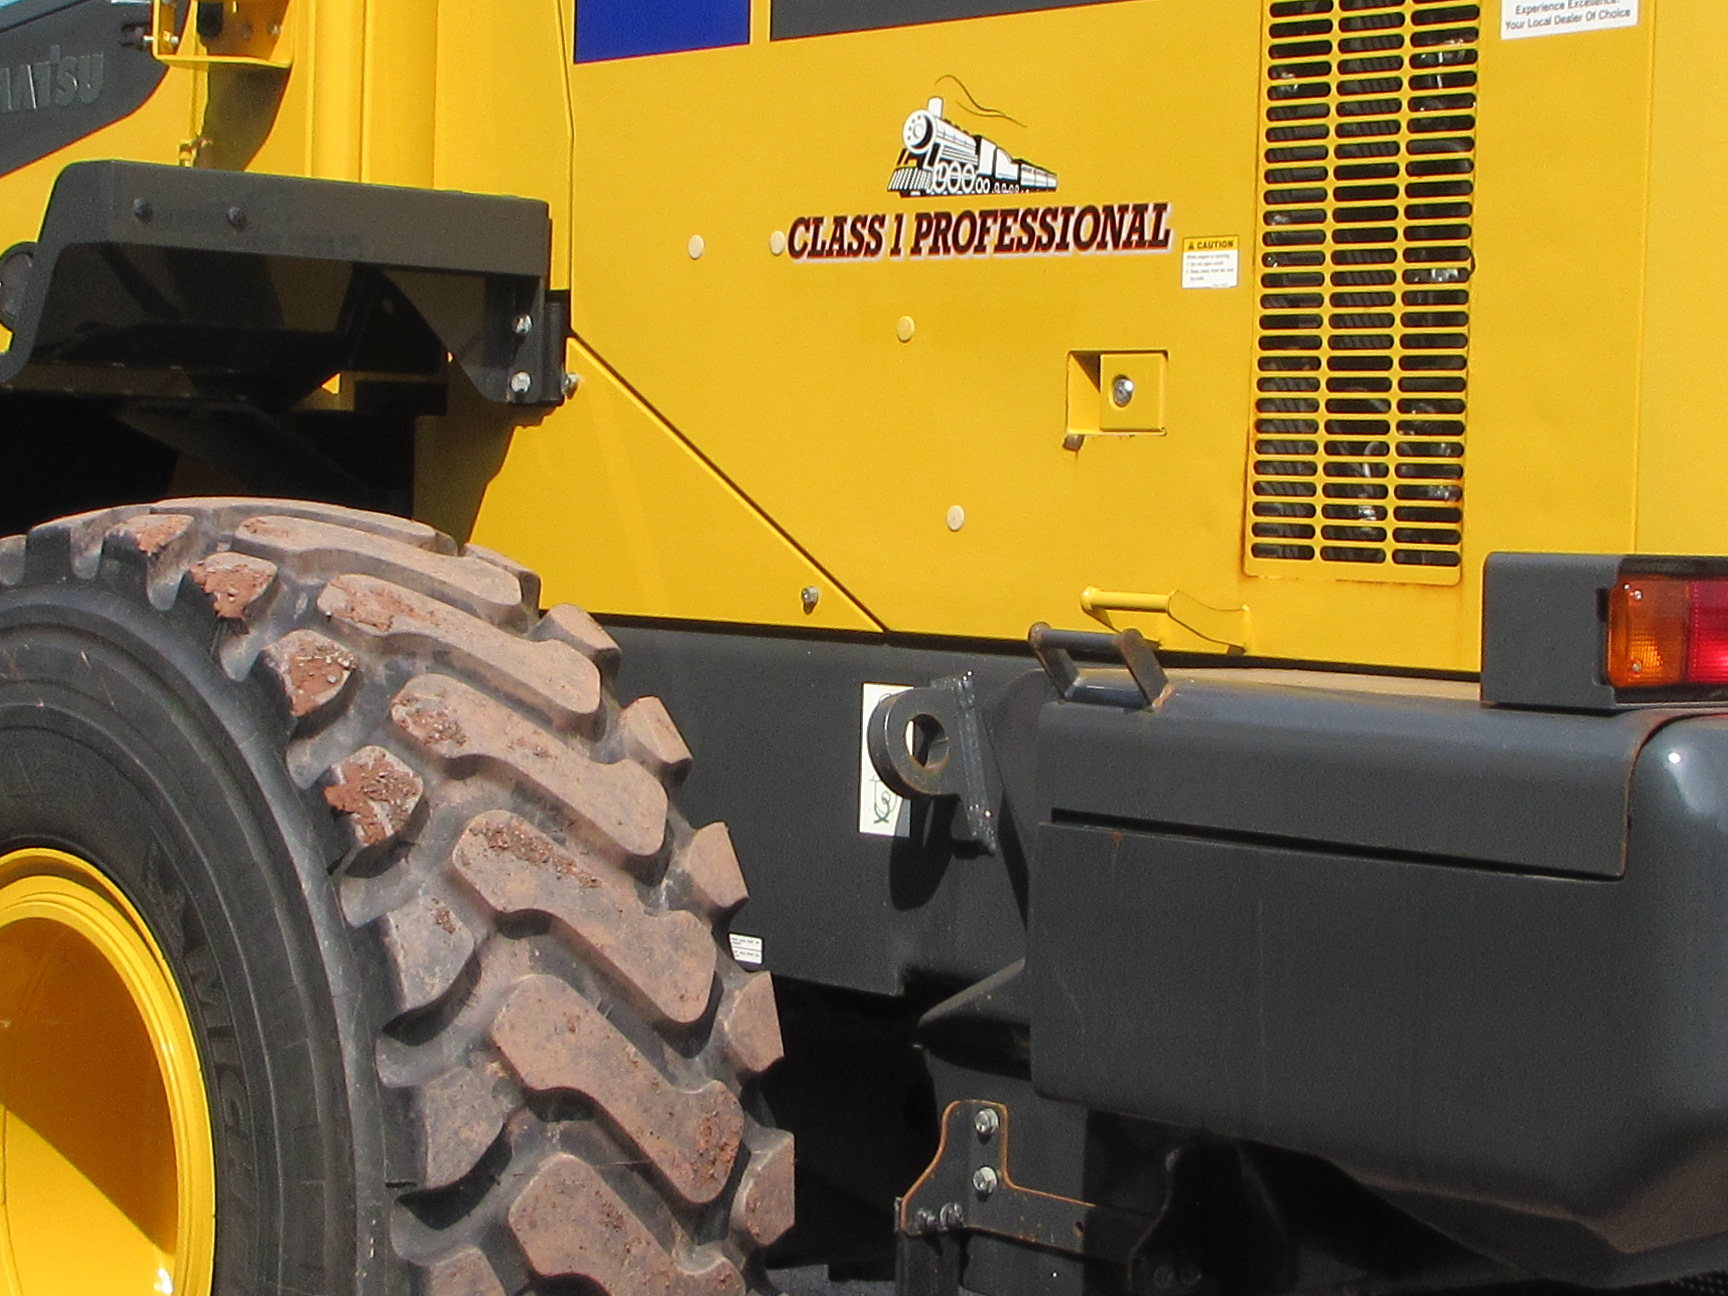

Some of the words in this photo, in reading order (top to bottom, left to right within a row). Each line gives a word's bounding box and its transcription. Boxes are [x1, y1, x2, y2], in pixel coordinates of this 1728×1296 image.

[1515, 1, 1565, 16] Experience
[1506, 19, 1526, 31] Your
[1527, 16, 1552, 29] Local
[1554, 12, 1583, 25] Dealer
[1598, 7, 1632, 21] Choice
[787, 214, 886, 260] CLASS
[912, 202, 1174, 257] PROFESSIONAL
[1196, 240, 1234, 250] CAUTION
